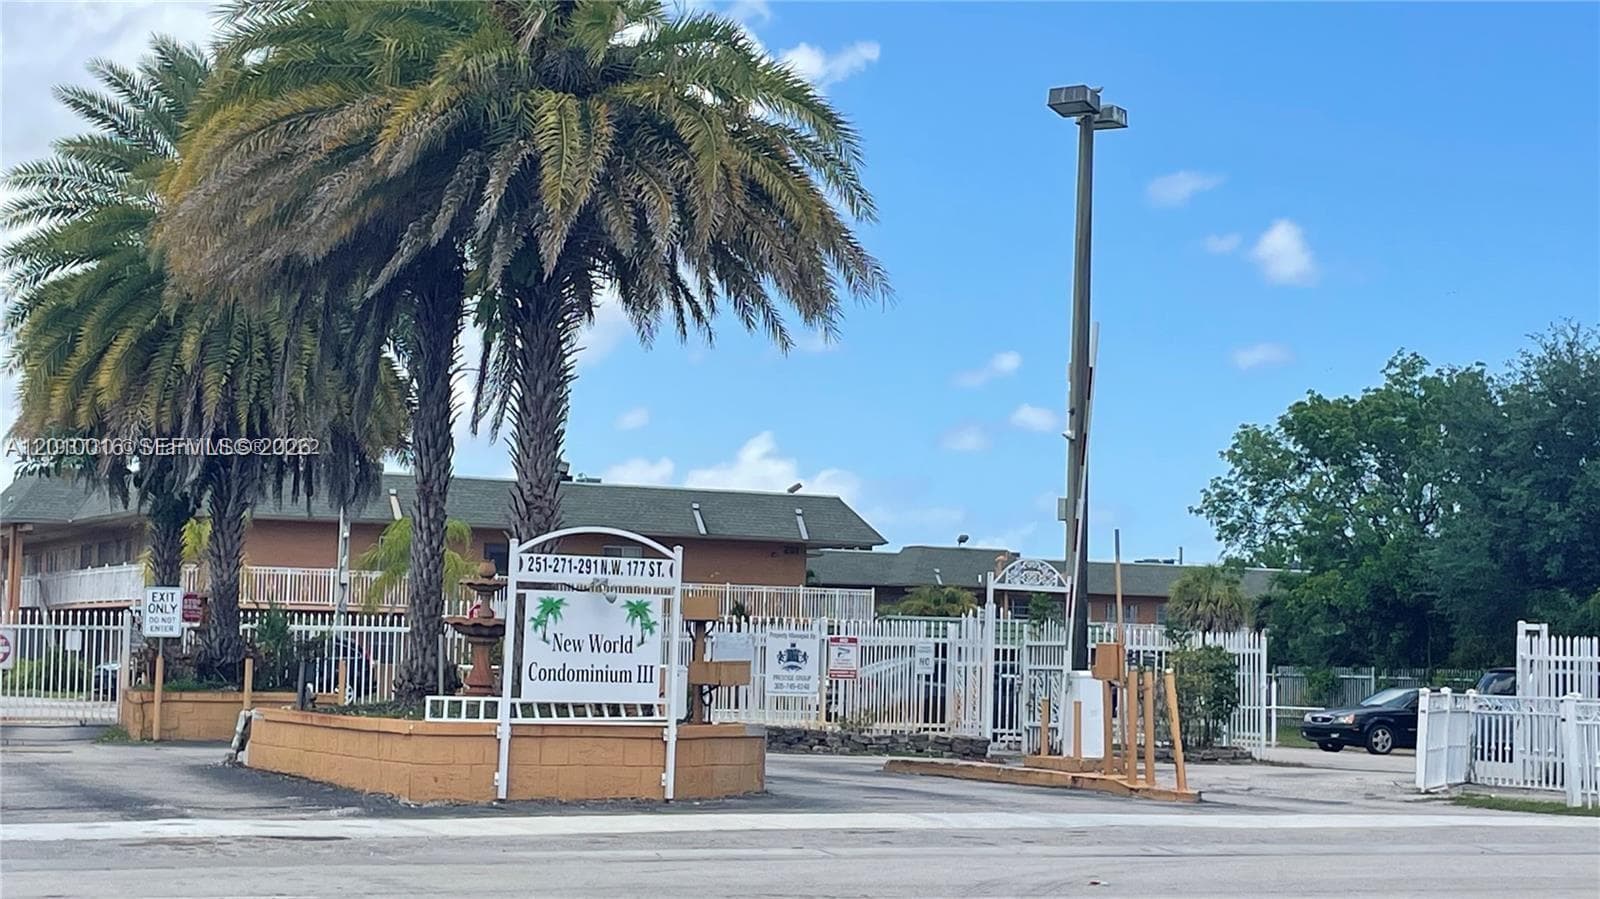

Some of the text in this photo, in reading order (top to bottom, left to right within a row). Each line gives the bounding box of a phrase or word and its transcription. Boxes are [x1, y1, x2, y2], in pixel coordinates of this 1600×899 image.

[528, 556, 665, 578] 251-271-291 N.W. 177 ST.
[152, 592, 176, 602] EXIT
[148, 603, 178, 614] ONLY
[149, 616, 176, 624] DO NOT
[150, 625, 174, 633] ENTER
[552, 632, 633, 654] New World
[528, 661, 654, 684] Condominium III
